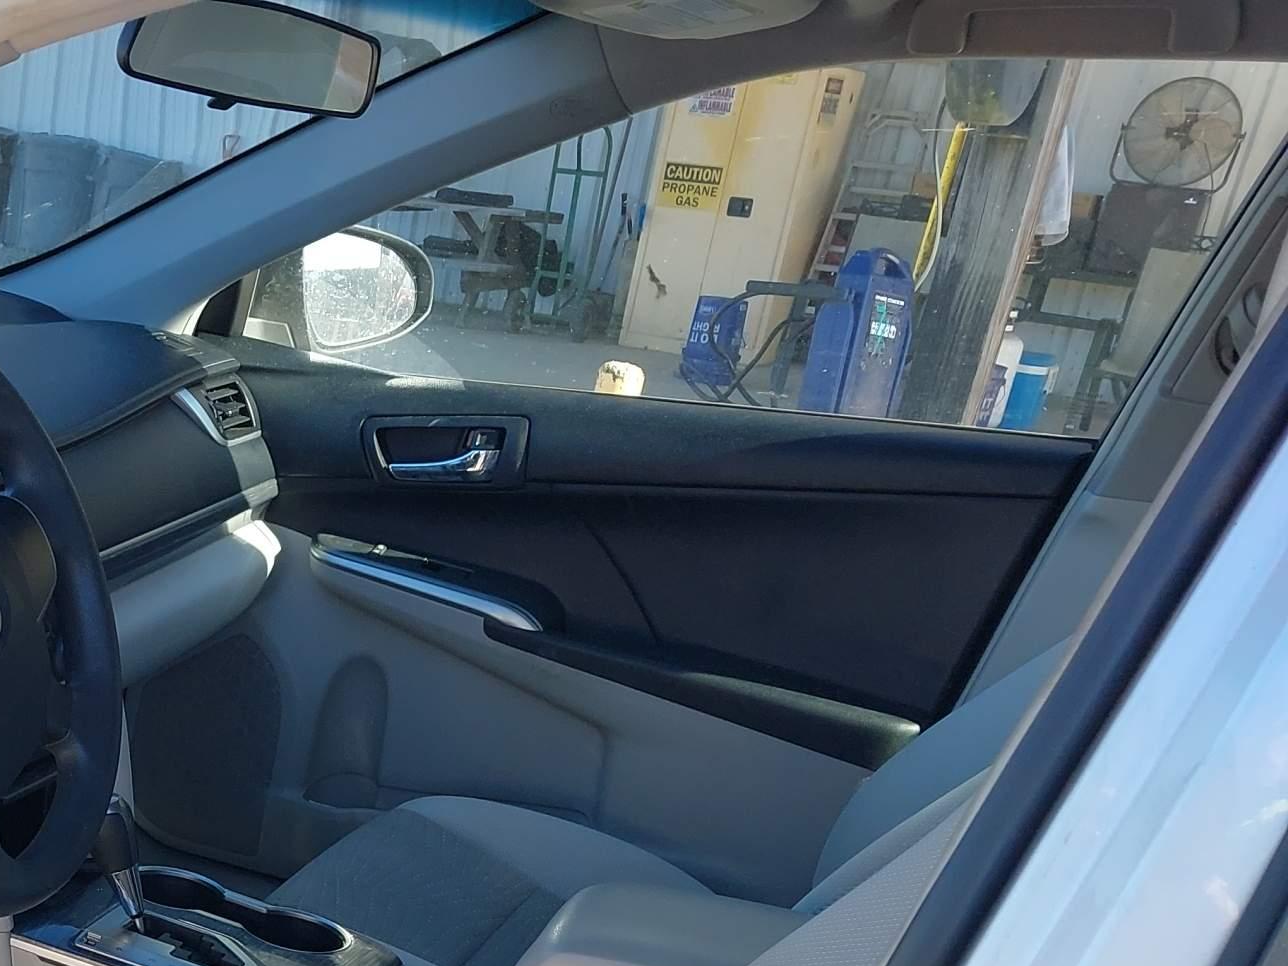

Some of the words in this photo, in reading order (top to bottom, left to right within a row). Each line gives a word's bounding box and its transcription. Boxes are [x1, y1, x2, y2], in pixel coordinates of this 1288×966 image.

[667, 165, 721, 184] CAUTION
[662, 181, 718, 197] PROPANE
[675, 195, 699, 208] GAS
[691, 321, 721, 333] RGHT
